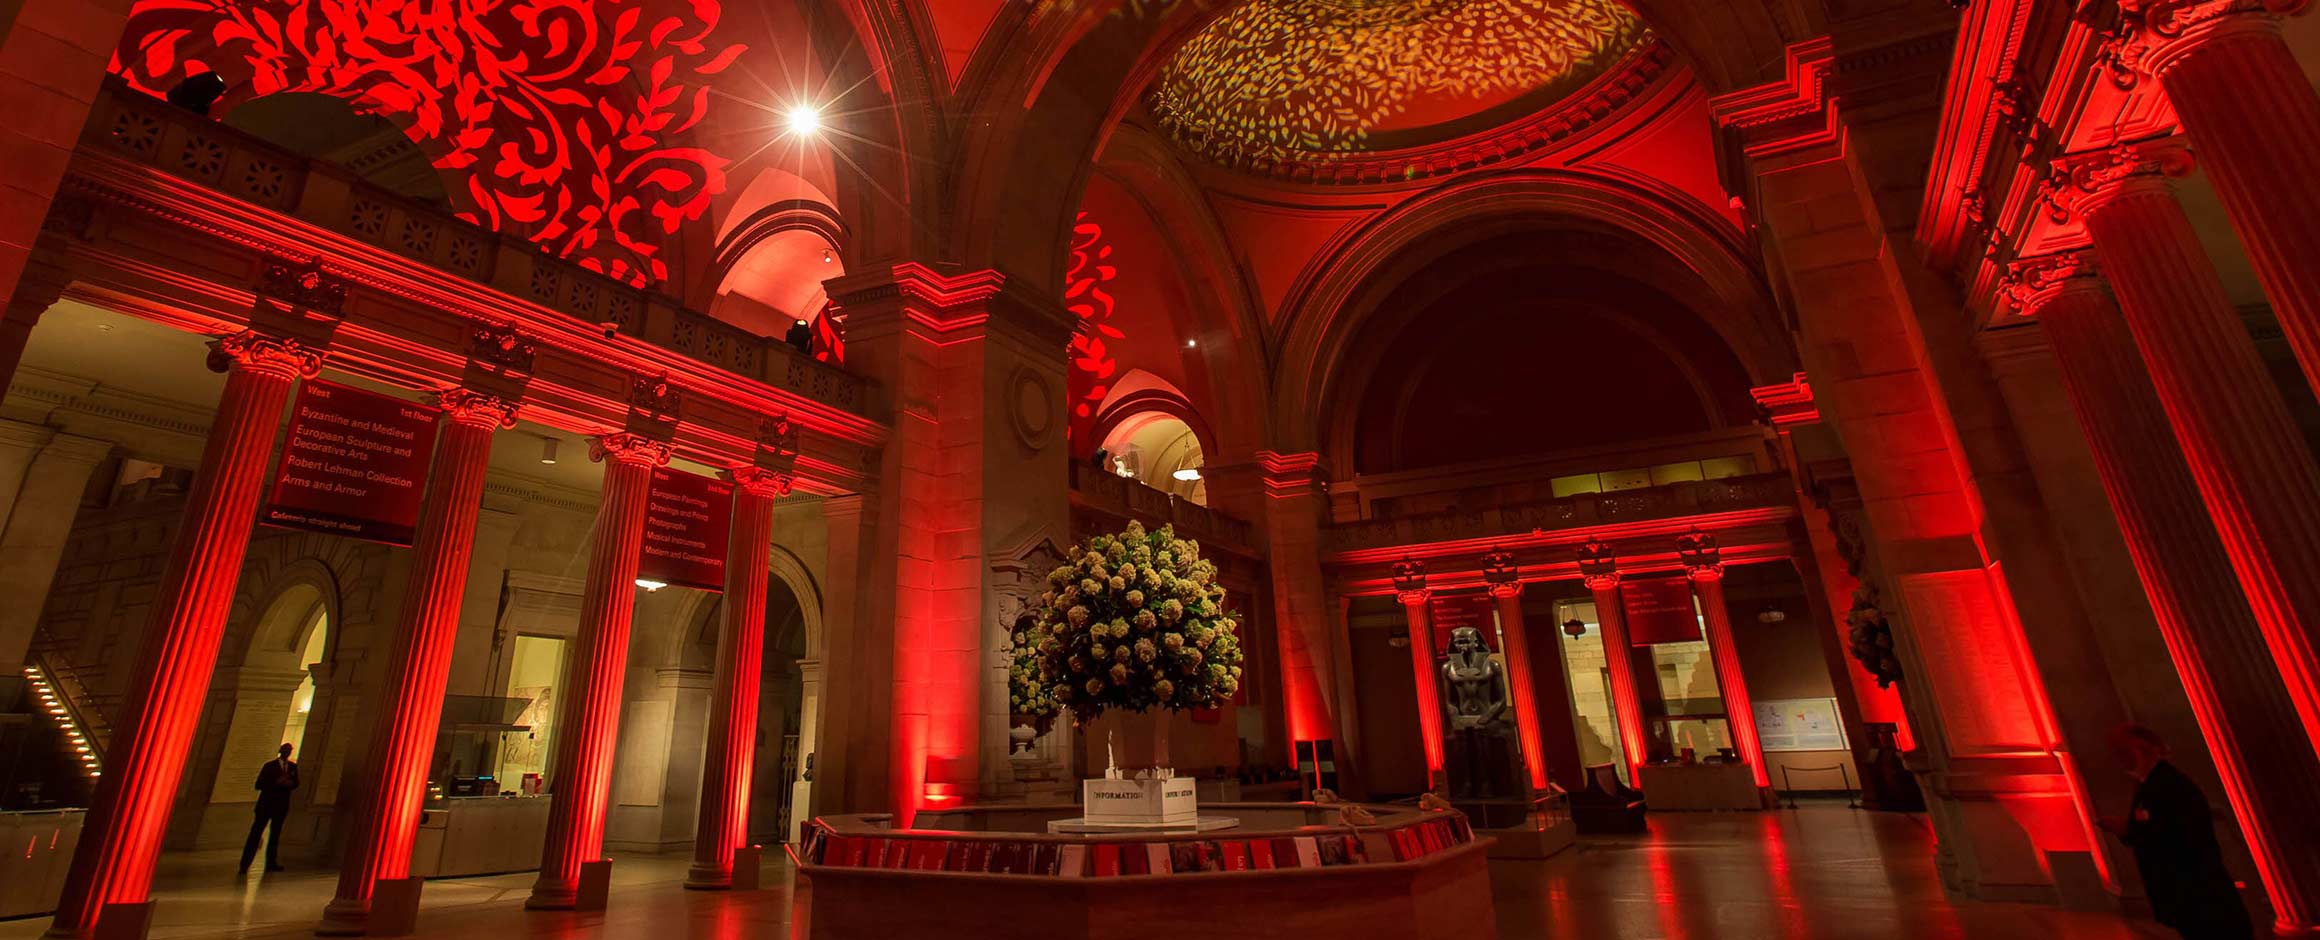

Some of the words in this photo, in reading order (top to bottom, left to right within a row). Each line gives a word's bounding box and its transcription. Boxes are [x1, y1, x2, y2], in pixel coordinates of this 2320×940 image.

[307, 385, 331, 399] West
[301, 406, 349, 425] Byzantine
[351, 417, 370, 431] and
[371, 422, 414, 441] Medieval
[401, 408, 412, 418] 1st
[413, 411, 433, 423] floor
[296, 424, 344, 443] European
[345, 435, 392, 454] Sculpture
[393, 445, 412, 457] and
[293, 437, 346, 457] Decorative
[347, 449, 368, 461] Arts
[288, 455, 322, 471] Robert
[324, 462, 364, 478] Lehman
[366, 470, 412, 488] Collection
[282, 474, 311, 488] Arms
[312, 478, 333, 492] and
[334, 483, 367, 497] Armor
[652, 488, 681, 501] European
[650, 502, 679, 516] Drawings
[680, 509, 692, 518] and
[308, 516, 337, 529] straight
[339, 521, 362, 532] ahead
[647, 531, 670, 542] Musical
[645, 545, 669, 556] Modern
[670, 550, 682, 559] and
